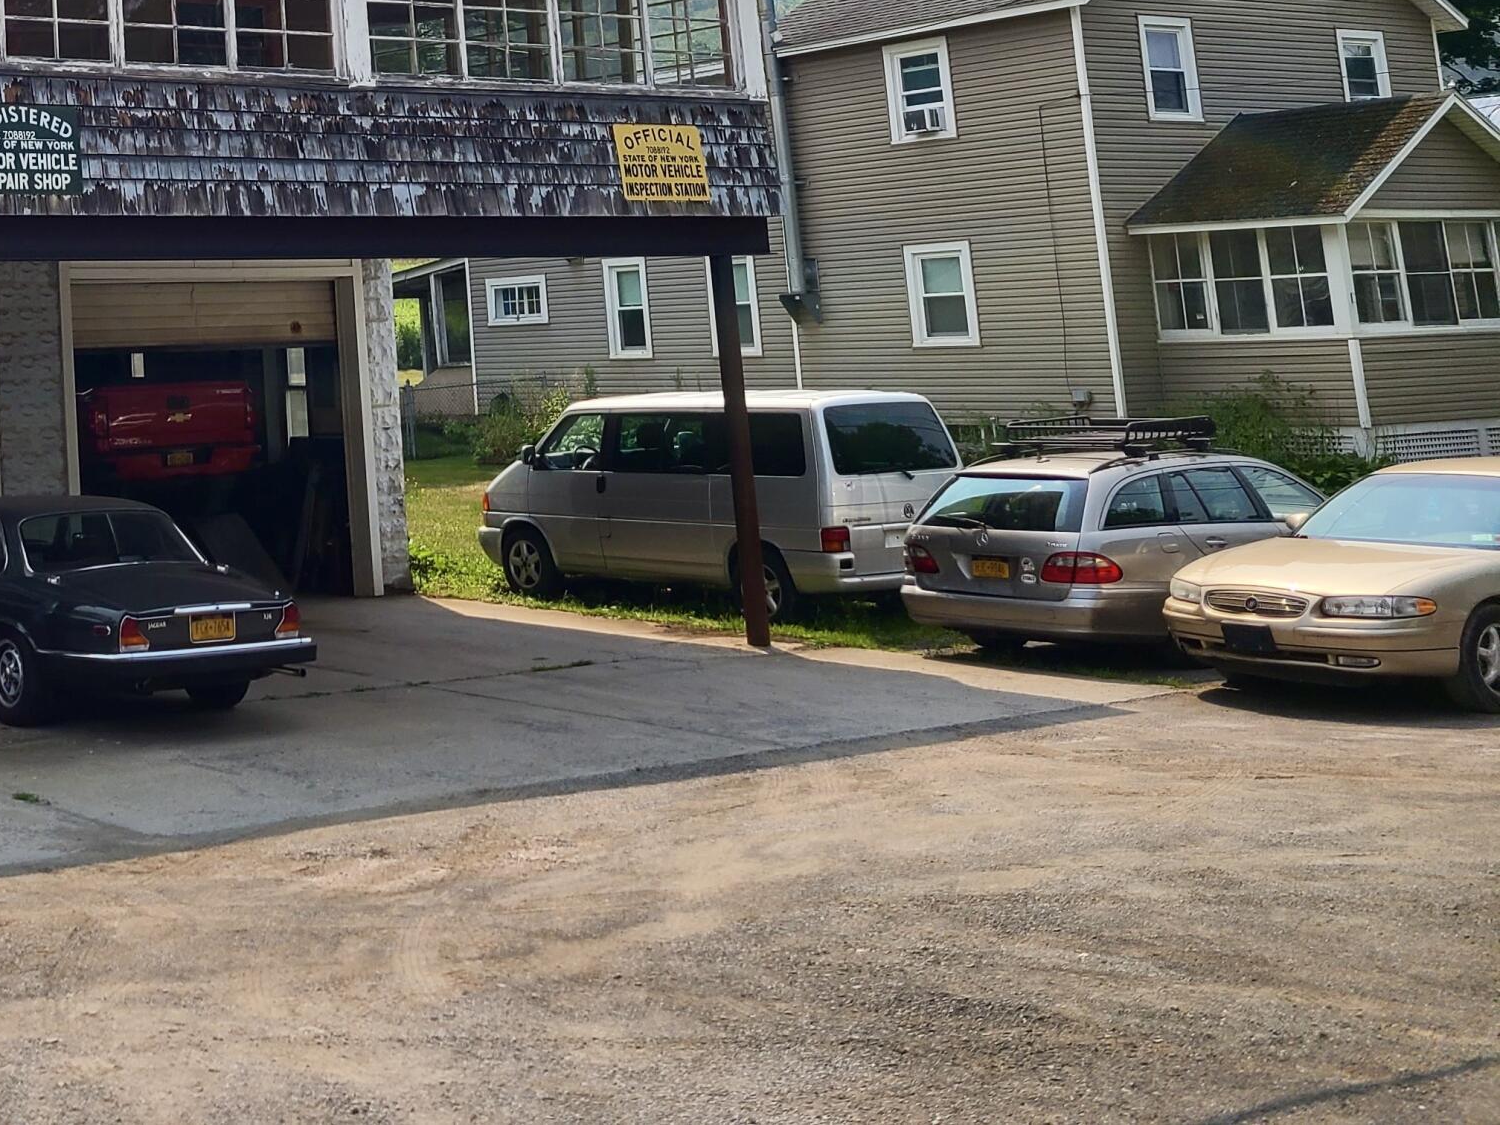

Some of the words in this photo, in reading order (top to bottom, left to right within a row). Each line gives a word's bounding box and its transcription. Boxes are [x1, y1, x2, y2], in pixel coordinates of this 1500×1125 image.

[3, 130, 36, 140] 7088192
[624, 128, 695, 151] OFFICIAL
[3, 140, 17, 150] OF
[21, 140, 43, 150] NEW
[47, 141, 74, 151] YORK
[19, 153, 78, 170] VEHICLE
[623, 155, 645, 163] STATE
[648, 155, 658, 163] OF
[624, 164, 658, 178] MOTOR
[660, 164, 703, 178] VEHICLE
[34, 173, 71, 190] SHOP
[626, 182, 673, 196] INSPECTION
[675, 183, 708, 197] STATION
